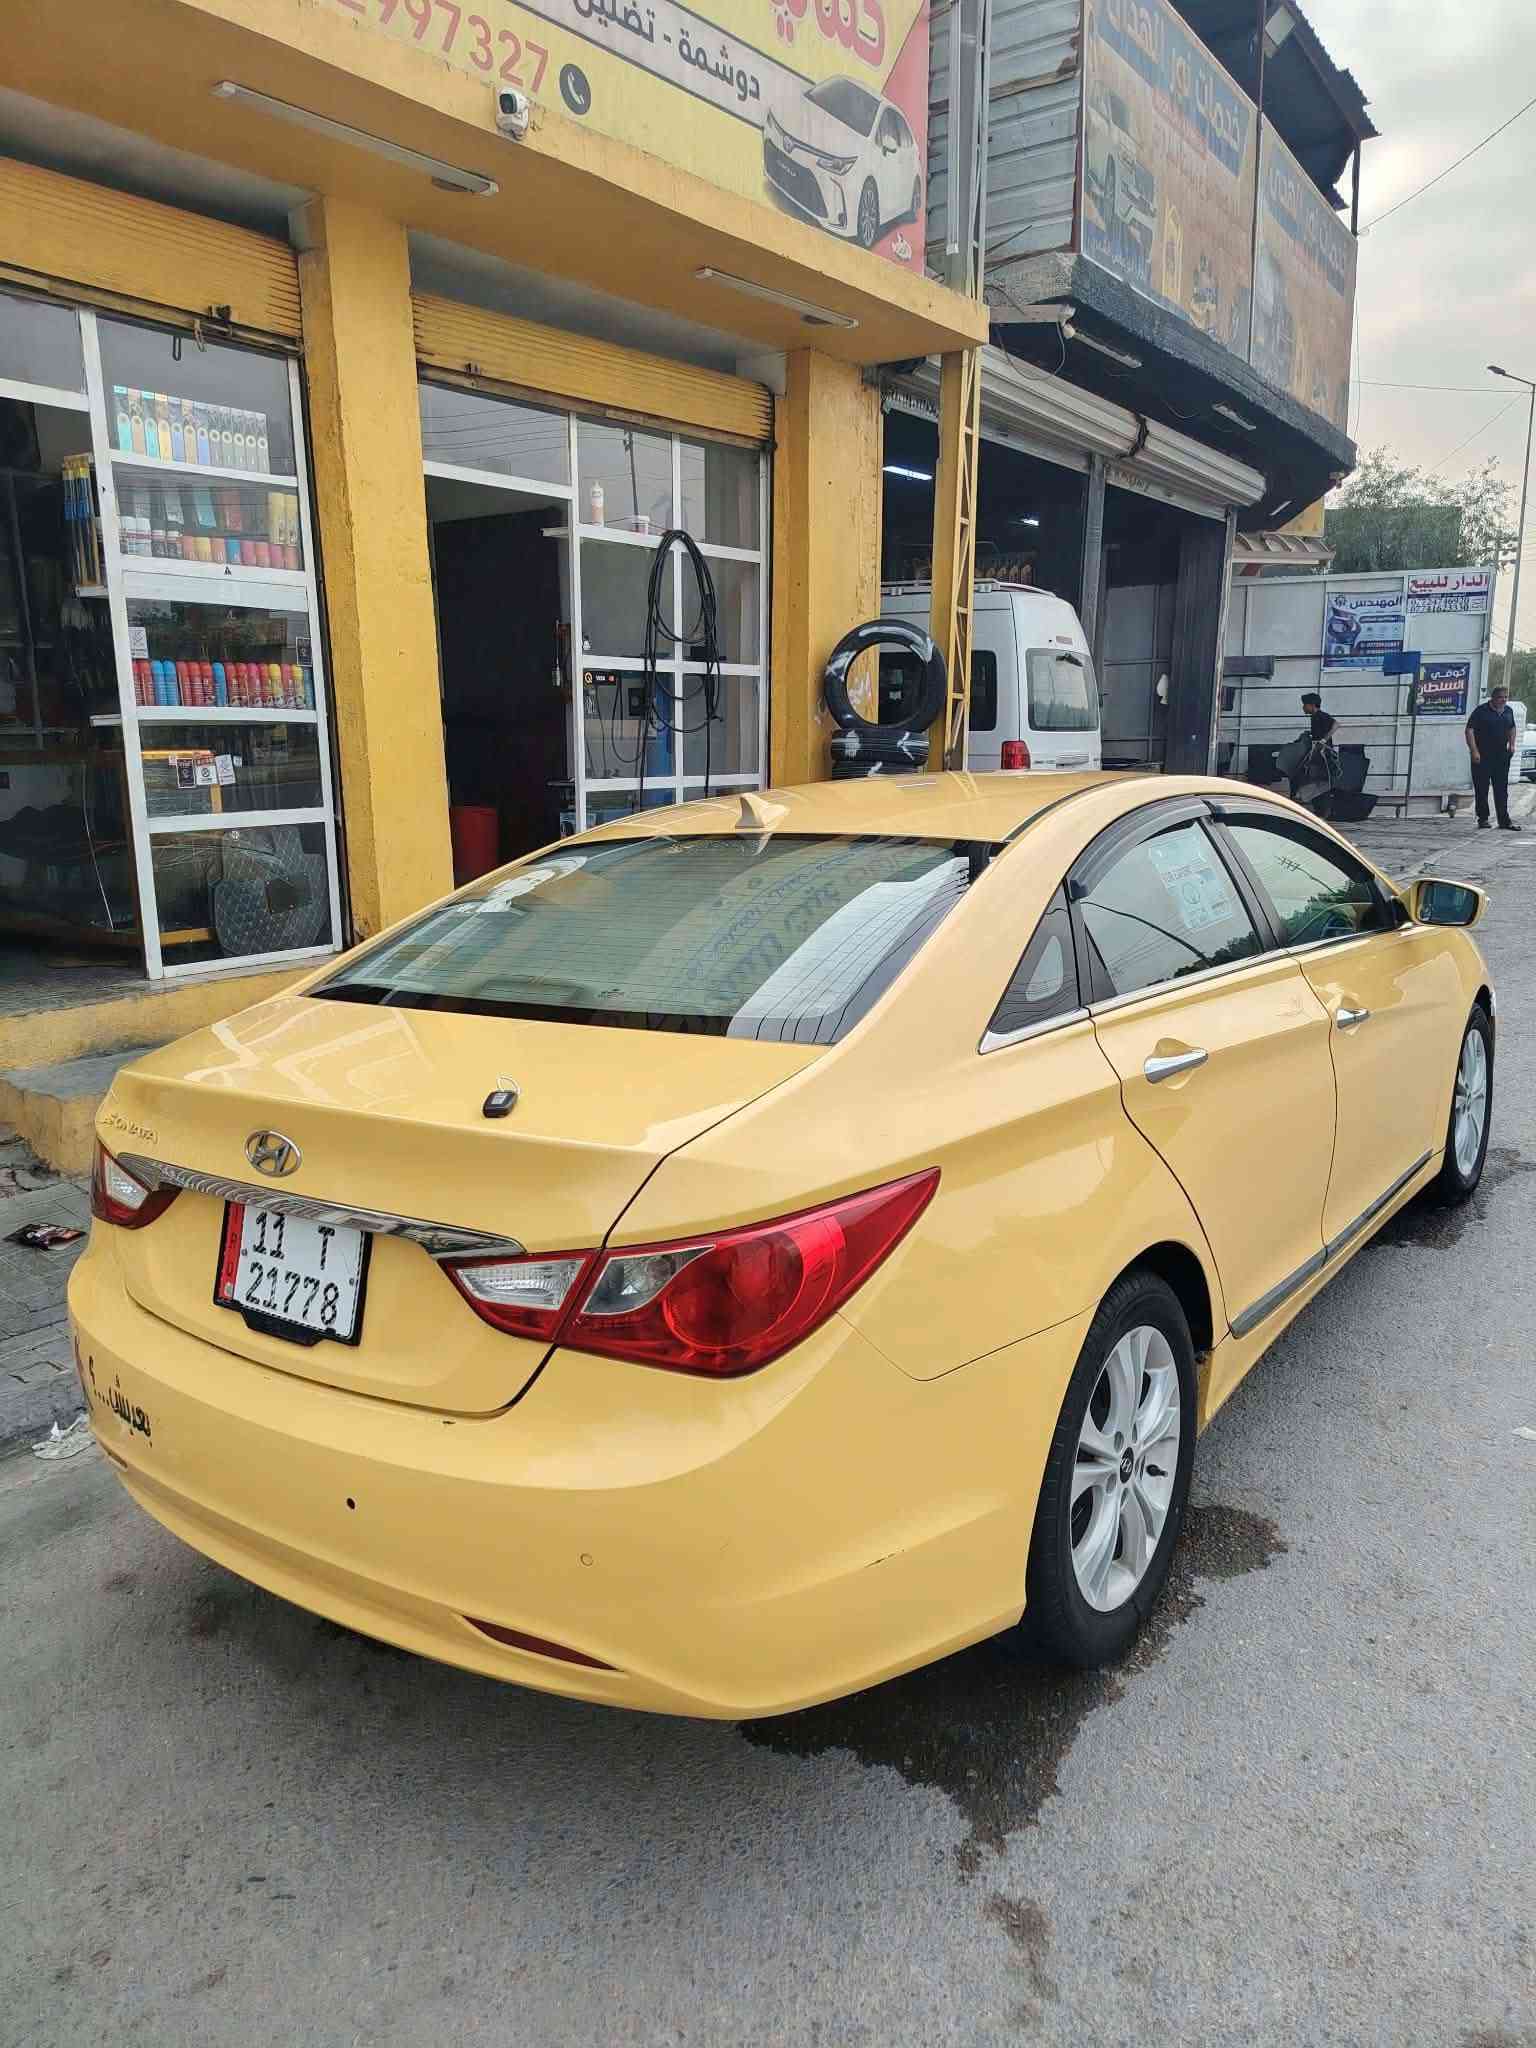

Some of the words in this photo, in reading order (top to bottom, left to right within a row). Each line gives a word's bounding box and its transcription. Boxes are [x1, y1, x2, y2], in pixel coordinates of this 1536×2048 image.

[335, 0, 549, 94] 97327
[678, 26, 762, 102] دوشمة
[1349, 594, 1403, 610] المهندس
[1409, 576, 1448, 594] للبيع
[1449, 573, 1488, 592] الدار
[252, 1210, 286, 1260] 11
[317, 1224, 336, 1271] T
[245, 1261, 340, 1326] 21778
